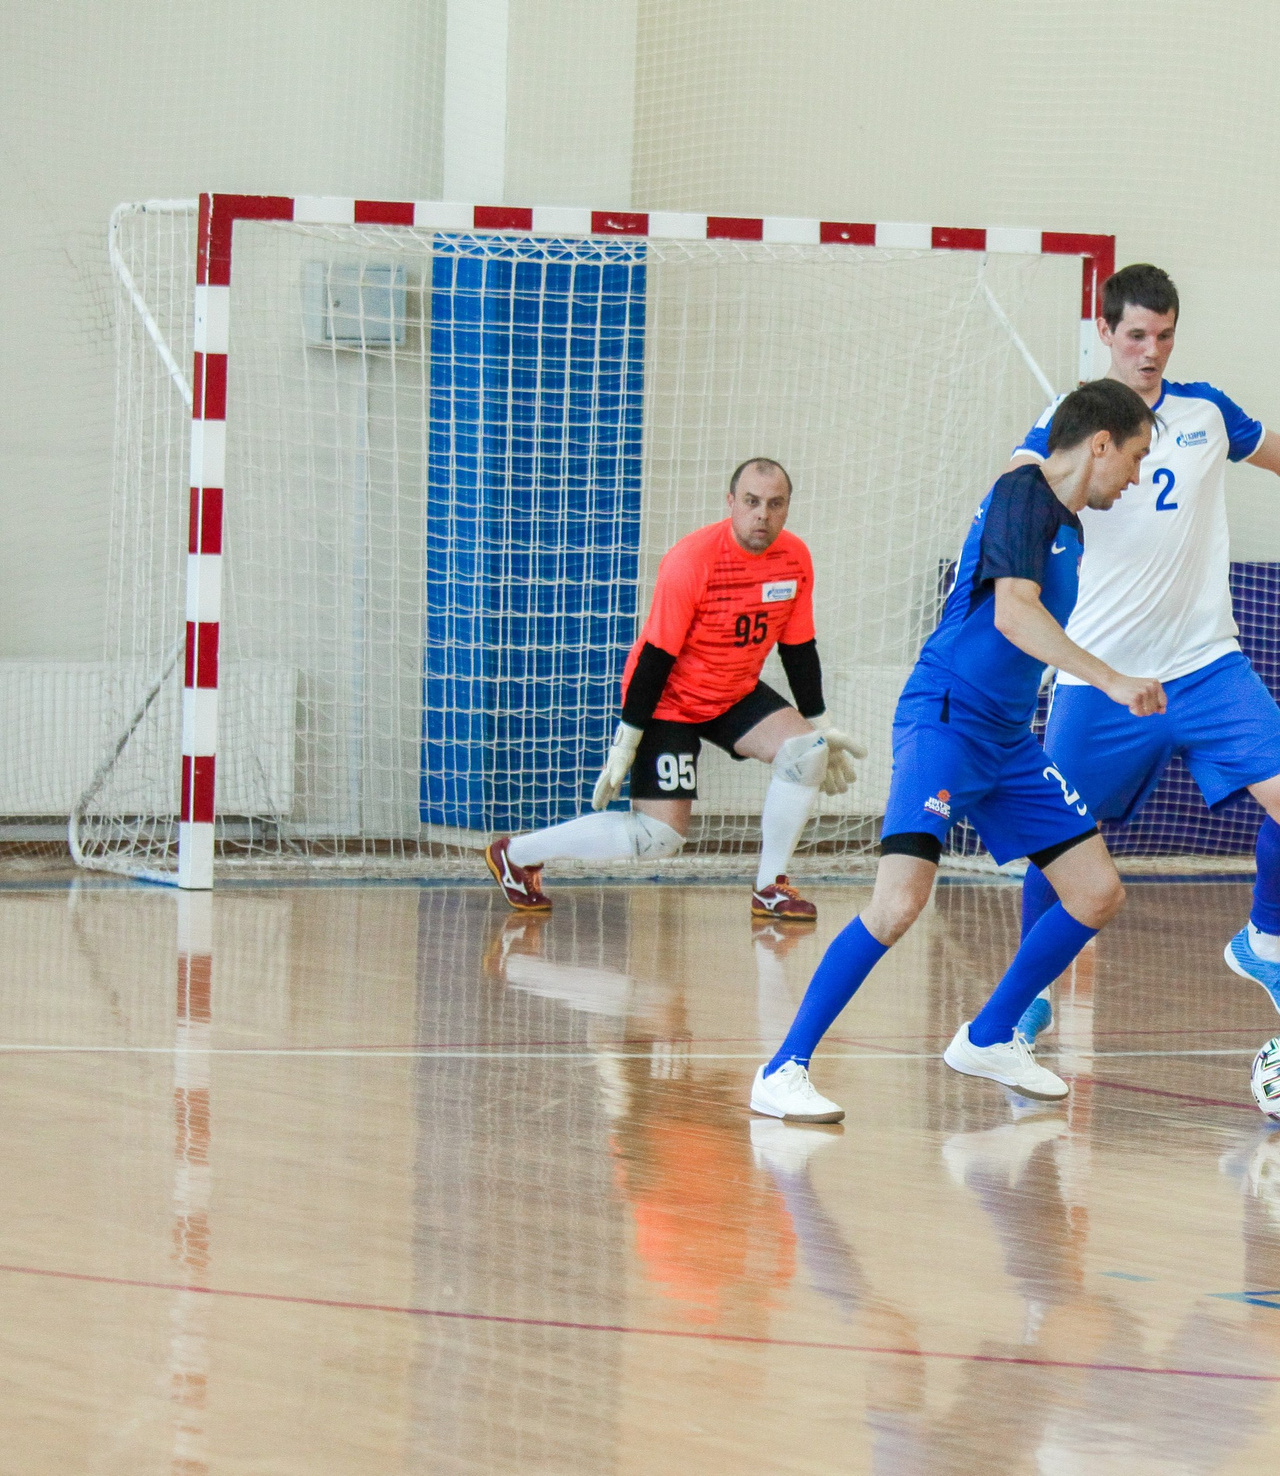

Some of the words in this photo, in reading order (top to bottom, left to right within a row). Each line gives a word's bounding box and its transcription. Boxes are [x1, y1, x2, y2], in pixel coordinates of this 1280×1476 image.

[1152, 467, 1178, 511] 2
[733, 611, 768, 648] 95
[657, 753, 696, 791] 95
